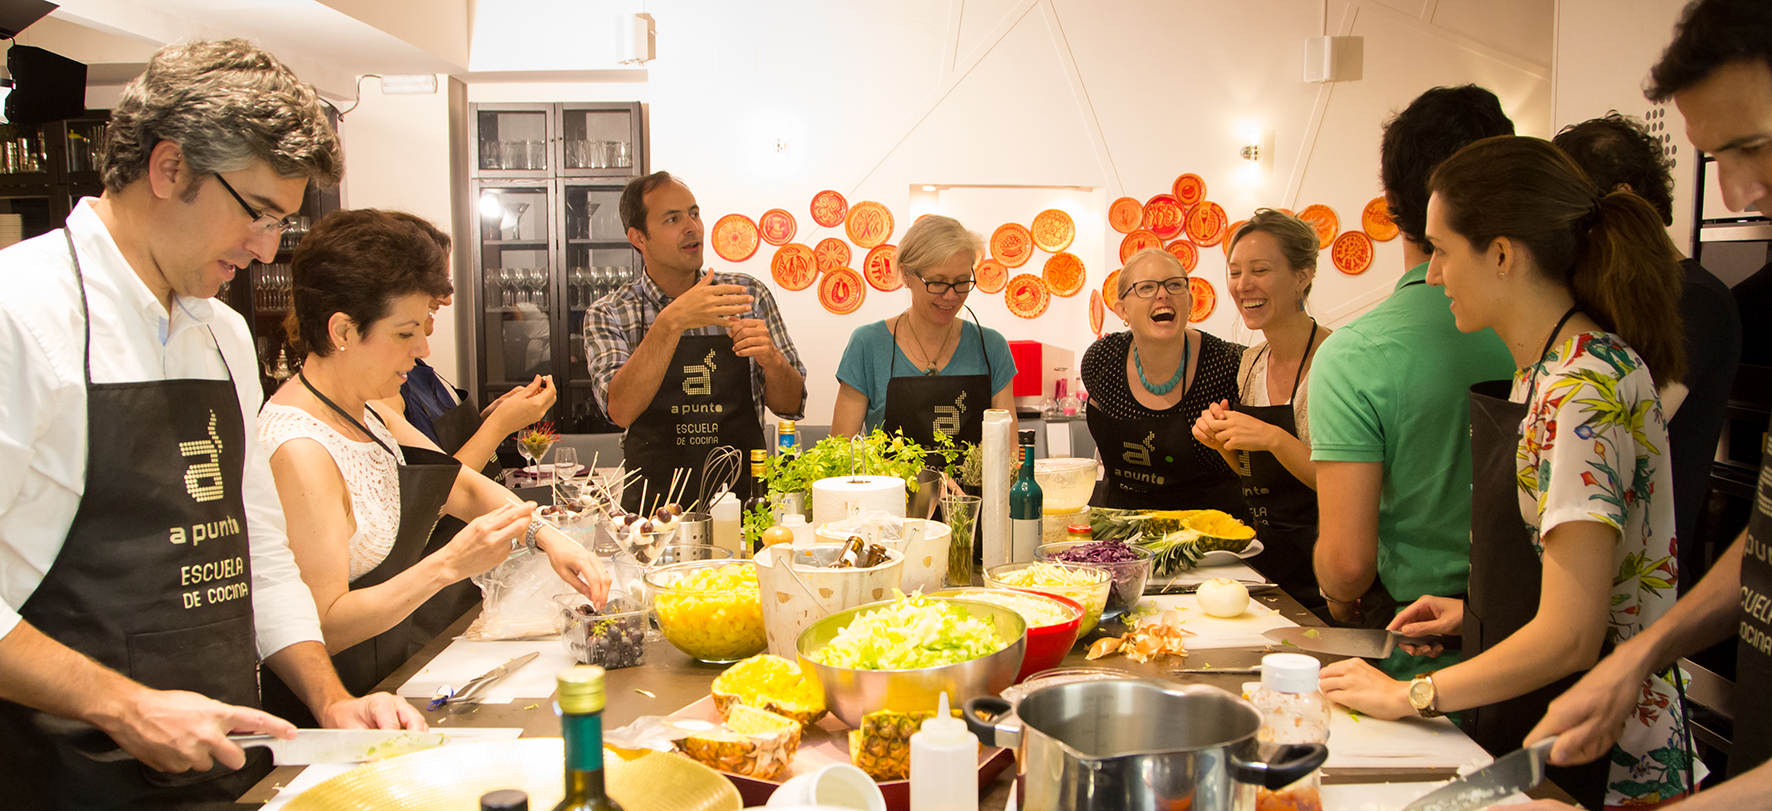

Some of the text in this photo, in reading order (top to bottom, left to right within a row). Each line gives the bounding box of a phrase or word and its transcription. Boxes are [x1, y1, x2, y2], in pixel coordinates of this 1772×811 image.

[671, 403, 723, 415] a punto
[676, 423, 719, 434] ESCUELA
[676, 436, 719, 446] DE COCINA
[1242, 486, 1270, 497] nto
[169, 515, 240, 546] a punto
[180, 556, 244, 586] ESCUELA
[182, 581, 249, 609] DE COCINA
[1740, 585, 1772, 625] CUEL
[1739, 621, 1772, 656] OCINA
